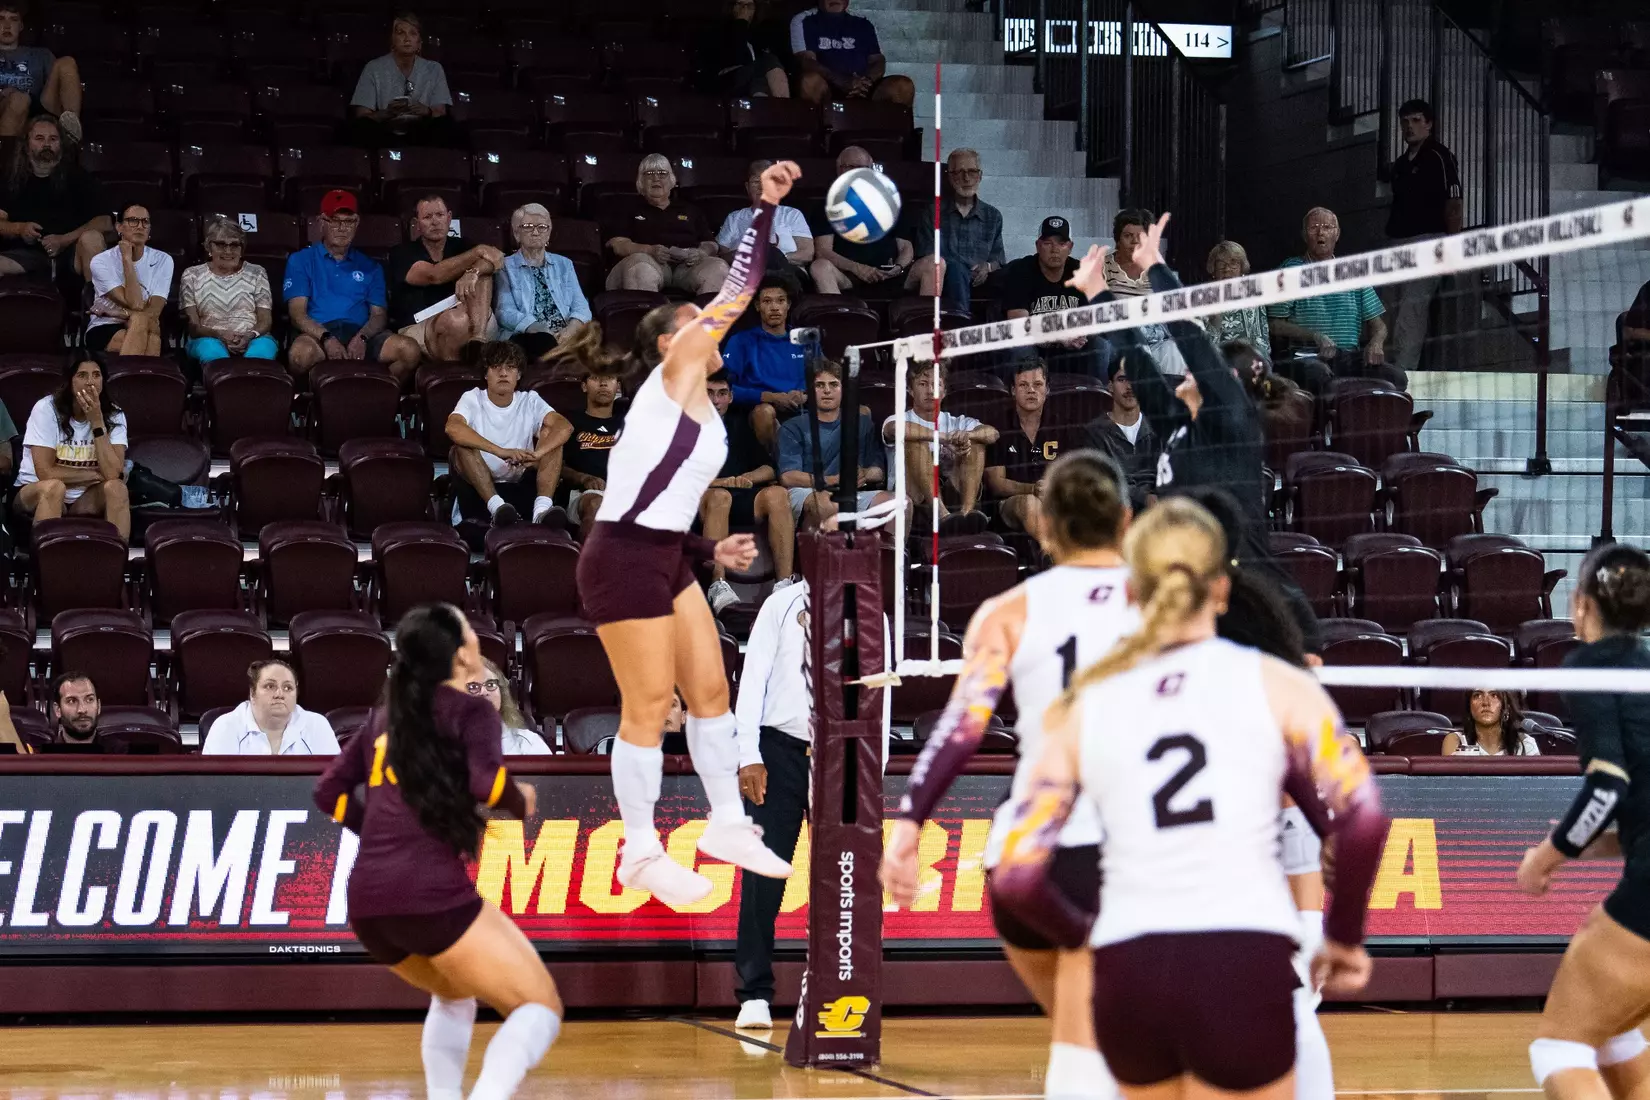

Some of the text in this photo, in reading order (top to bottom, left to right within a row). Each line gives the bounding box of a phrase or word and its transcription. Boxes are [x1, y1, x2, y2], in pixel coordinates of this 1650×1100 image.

[1185, 32, 1210, 48] 114
[1043, 440, 1059, 461] C
[1147, 733, 1214, 829] 2
[0, 809, 309, 927] LCOME
[835, 851, 855, 981] sports imports
[269, 945, 341, 953] DAKTRONICS
